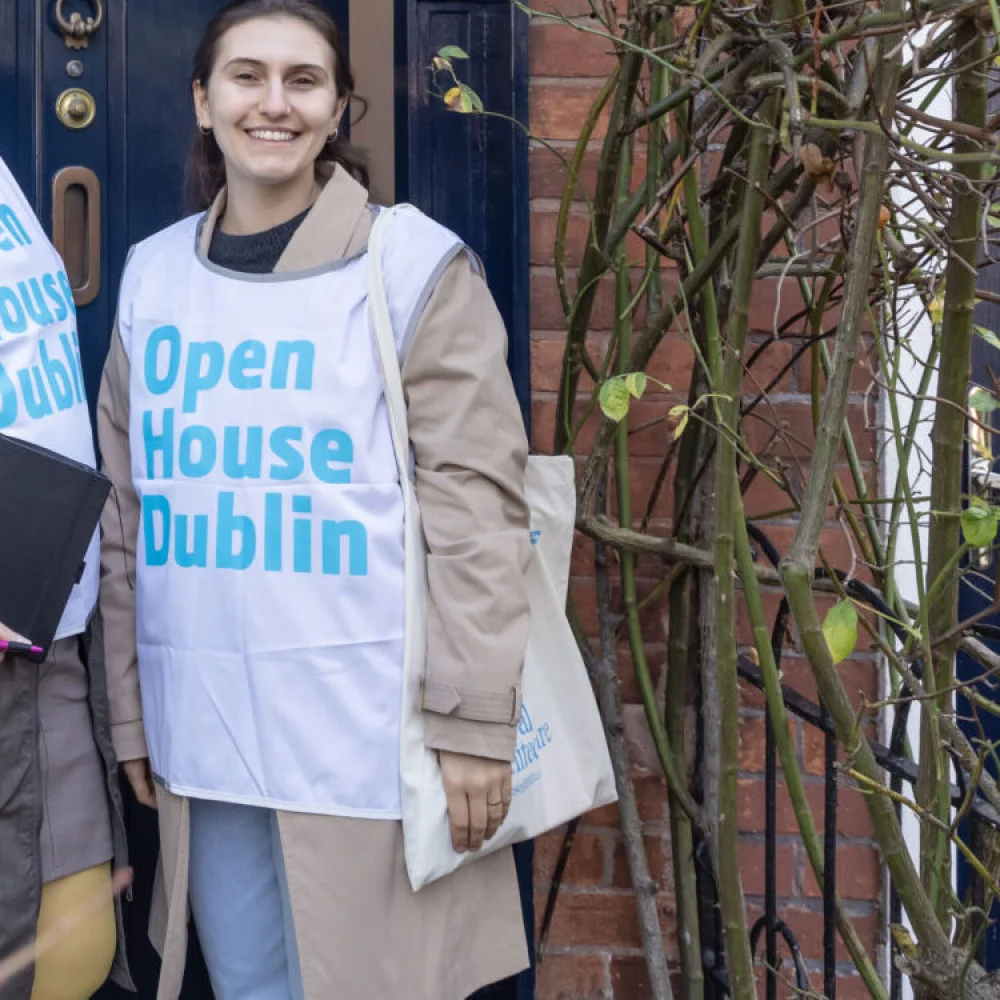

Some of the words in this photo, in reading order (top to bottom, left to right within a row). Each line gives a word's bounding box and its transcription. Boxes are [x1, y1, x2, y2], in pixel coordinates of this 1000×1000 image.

[144, 325, 315, 413] Open
[142, 408, 354, 484] House
[143, 491, 368, 576] Dublin
